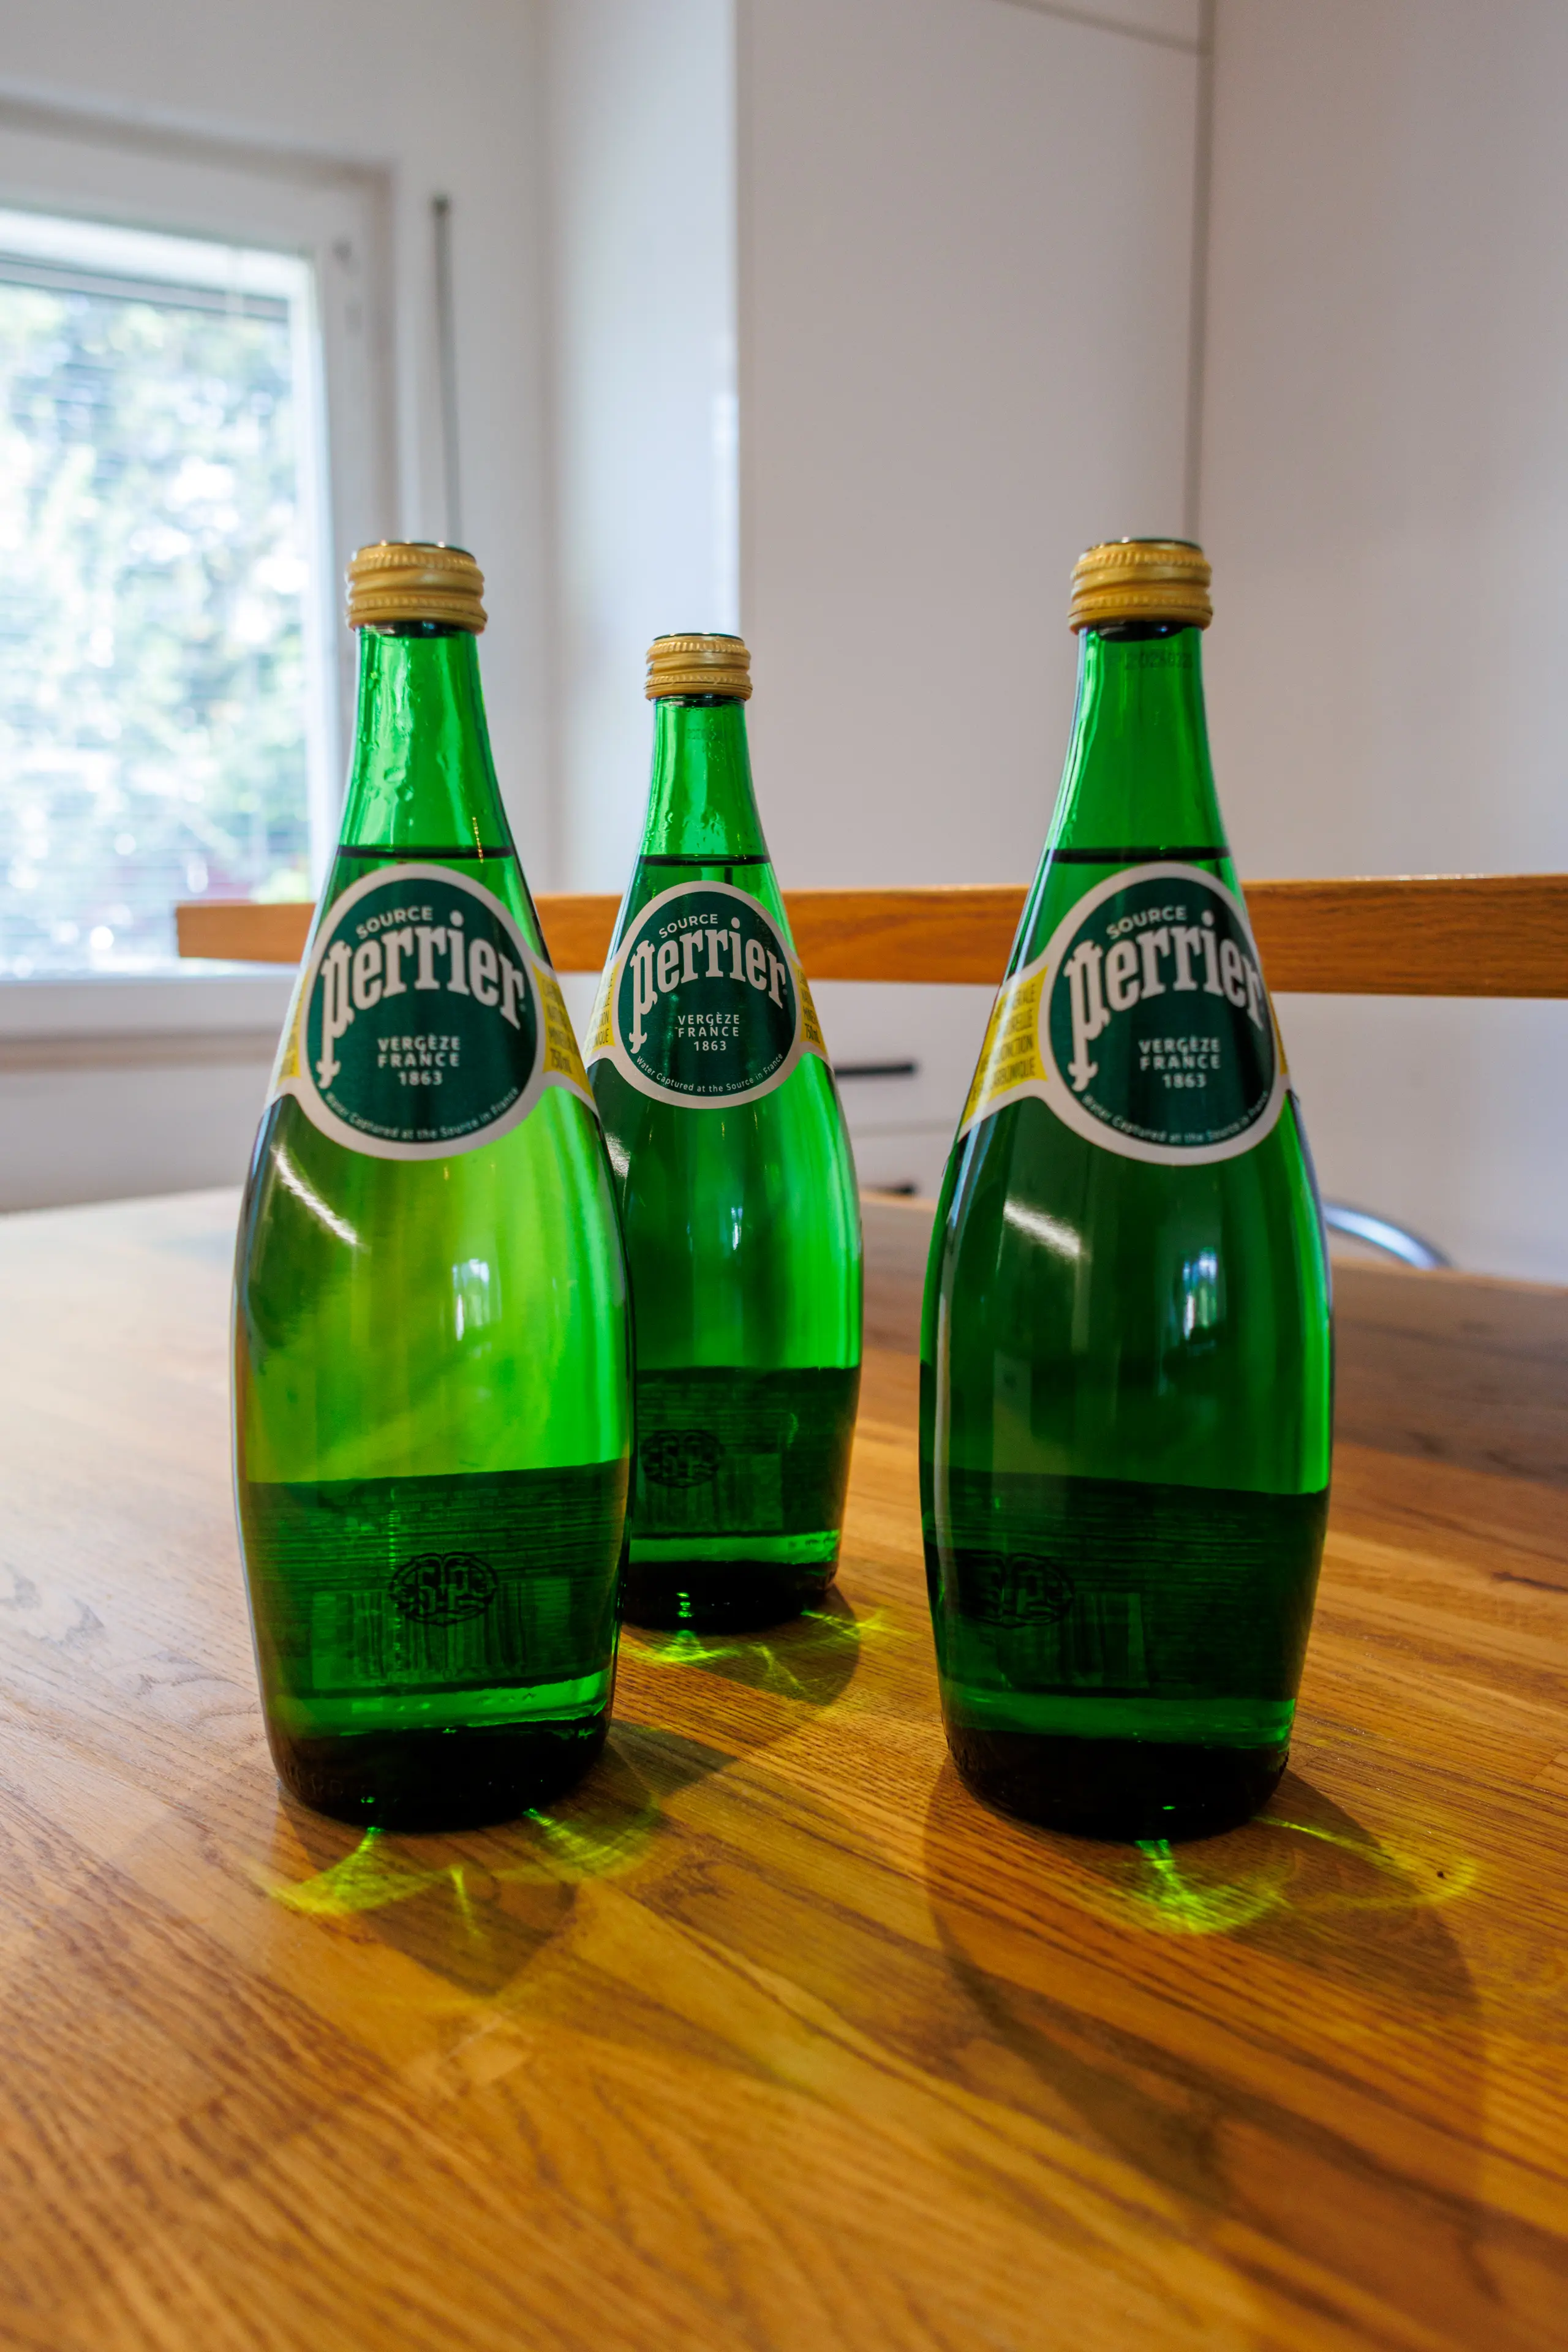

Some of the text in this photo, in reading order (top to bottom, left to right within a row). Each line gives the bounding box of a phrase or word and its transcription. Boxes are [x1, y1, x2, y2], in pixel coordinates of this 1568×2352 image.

[356, 905, 434, 940] SOURCE
[658, 914, 718, 939] SOURCE
[1106, 905, 1188, 940] SOURCE
[677, 1012, 740, 1027] VERGÈZE
[677, 1027, 739, 1038] FRANCE
[693, 1040, 726, 1052] 1863
[377, 1052, 460, 1068] FRANCE
[1140, 1054, 1221, 1071] FRANCE
[398, 1069, 443, 1086] 1863
[636, 1055, 655, 1076] Water
[656, 1072, 695, 1091] Captured
[708, 1084, 723, 1093] the
[726, 1077, 755, 1091] Source
[762, 1053, 783, 1075] France
[1163, 1072, 1207, 1088] 1863
